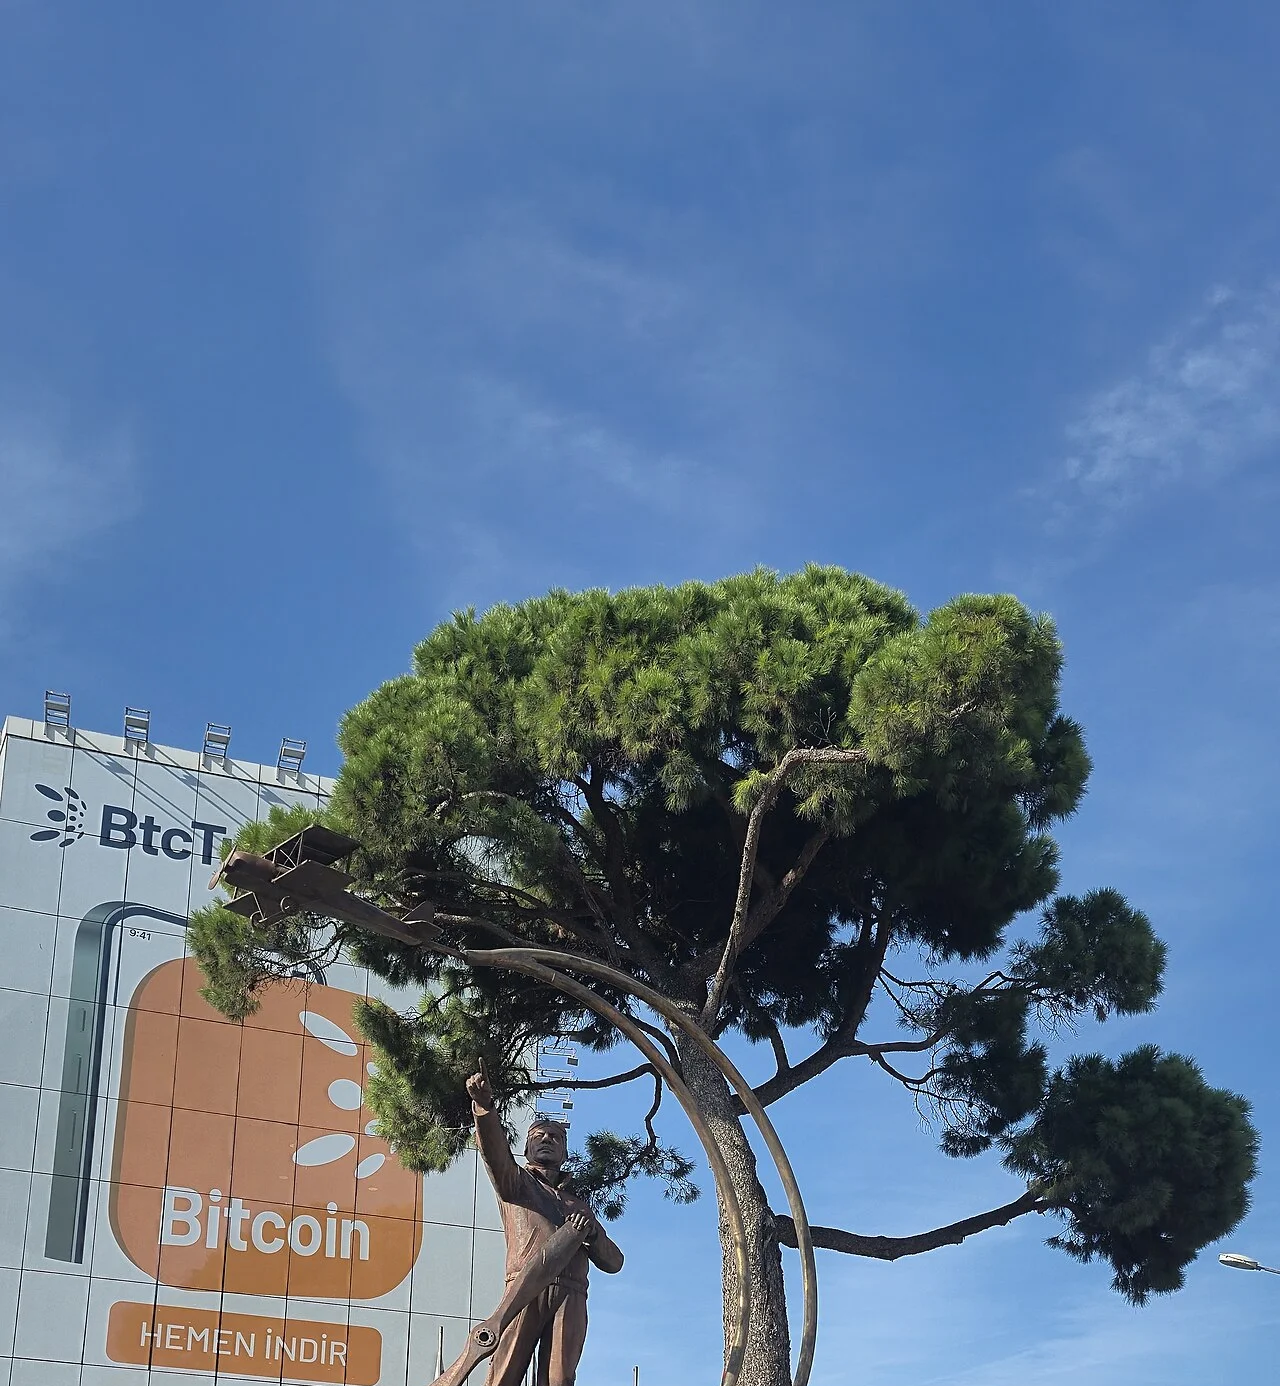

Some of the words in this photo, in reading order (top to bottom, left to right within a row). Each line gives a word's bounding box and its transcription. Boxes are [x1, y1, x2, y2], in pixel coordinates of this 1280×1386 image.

[99, 804, 232, 866] BtcT
[129, 928, 152, 941] 9:41
[158, 1185, 370, 1261] Bitcoin
[140, 1321, 256, 1359] HEMEN
[265, 1327, 348, 1367] İNDİR
